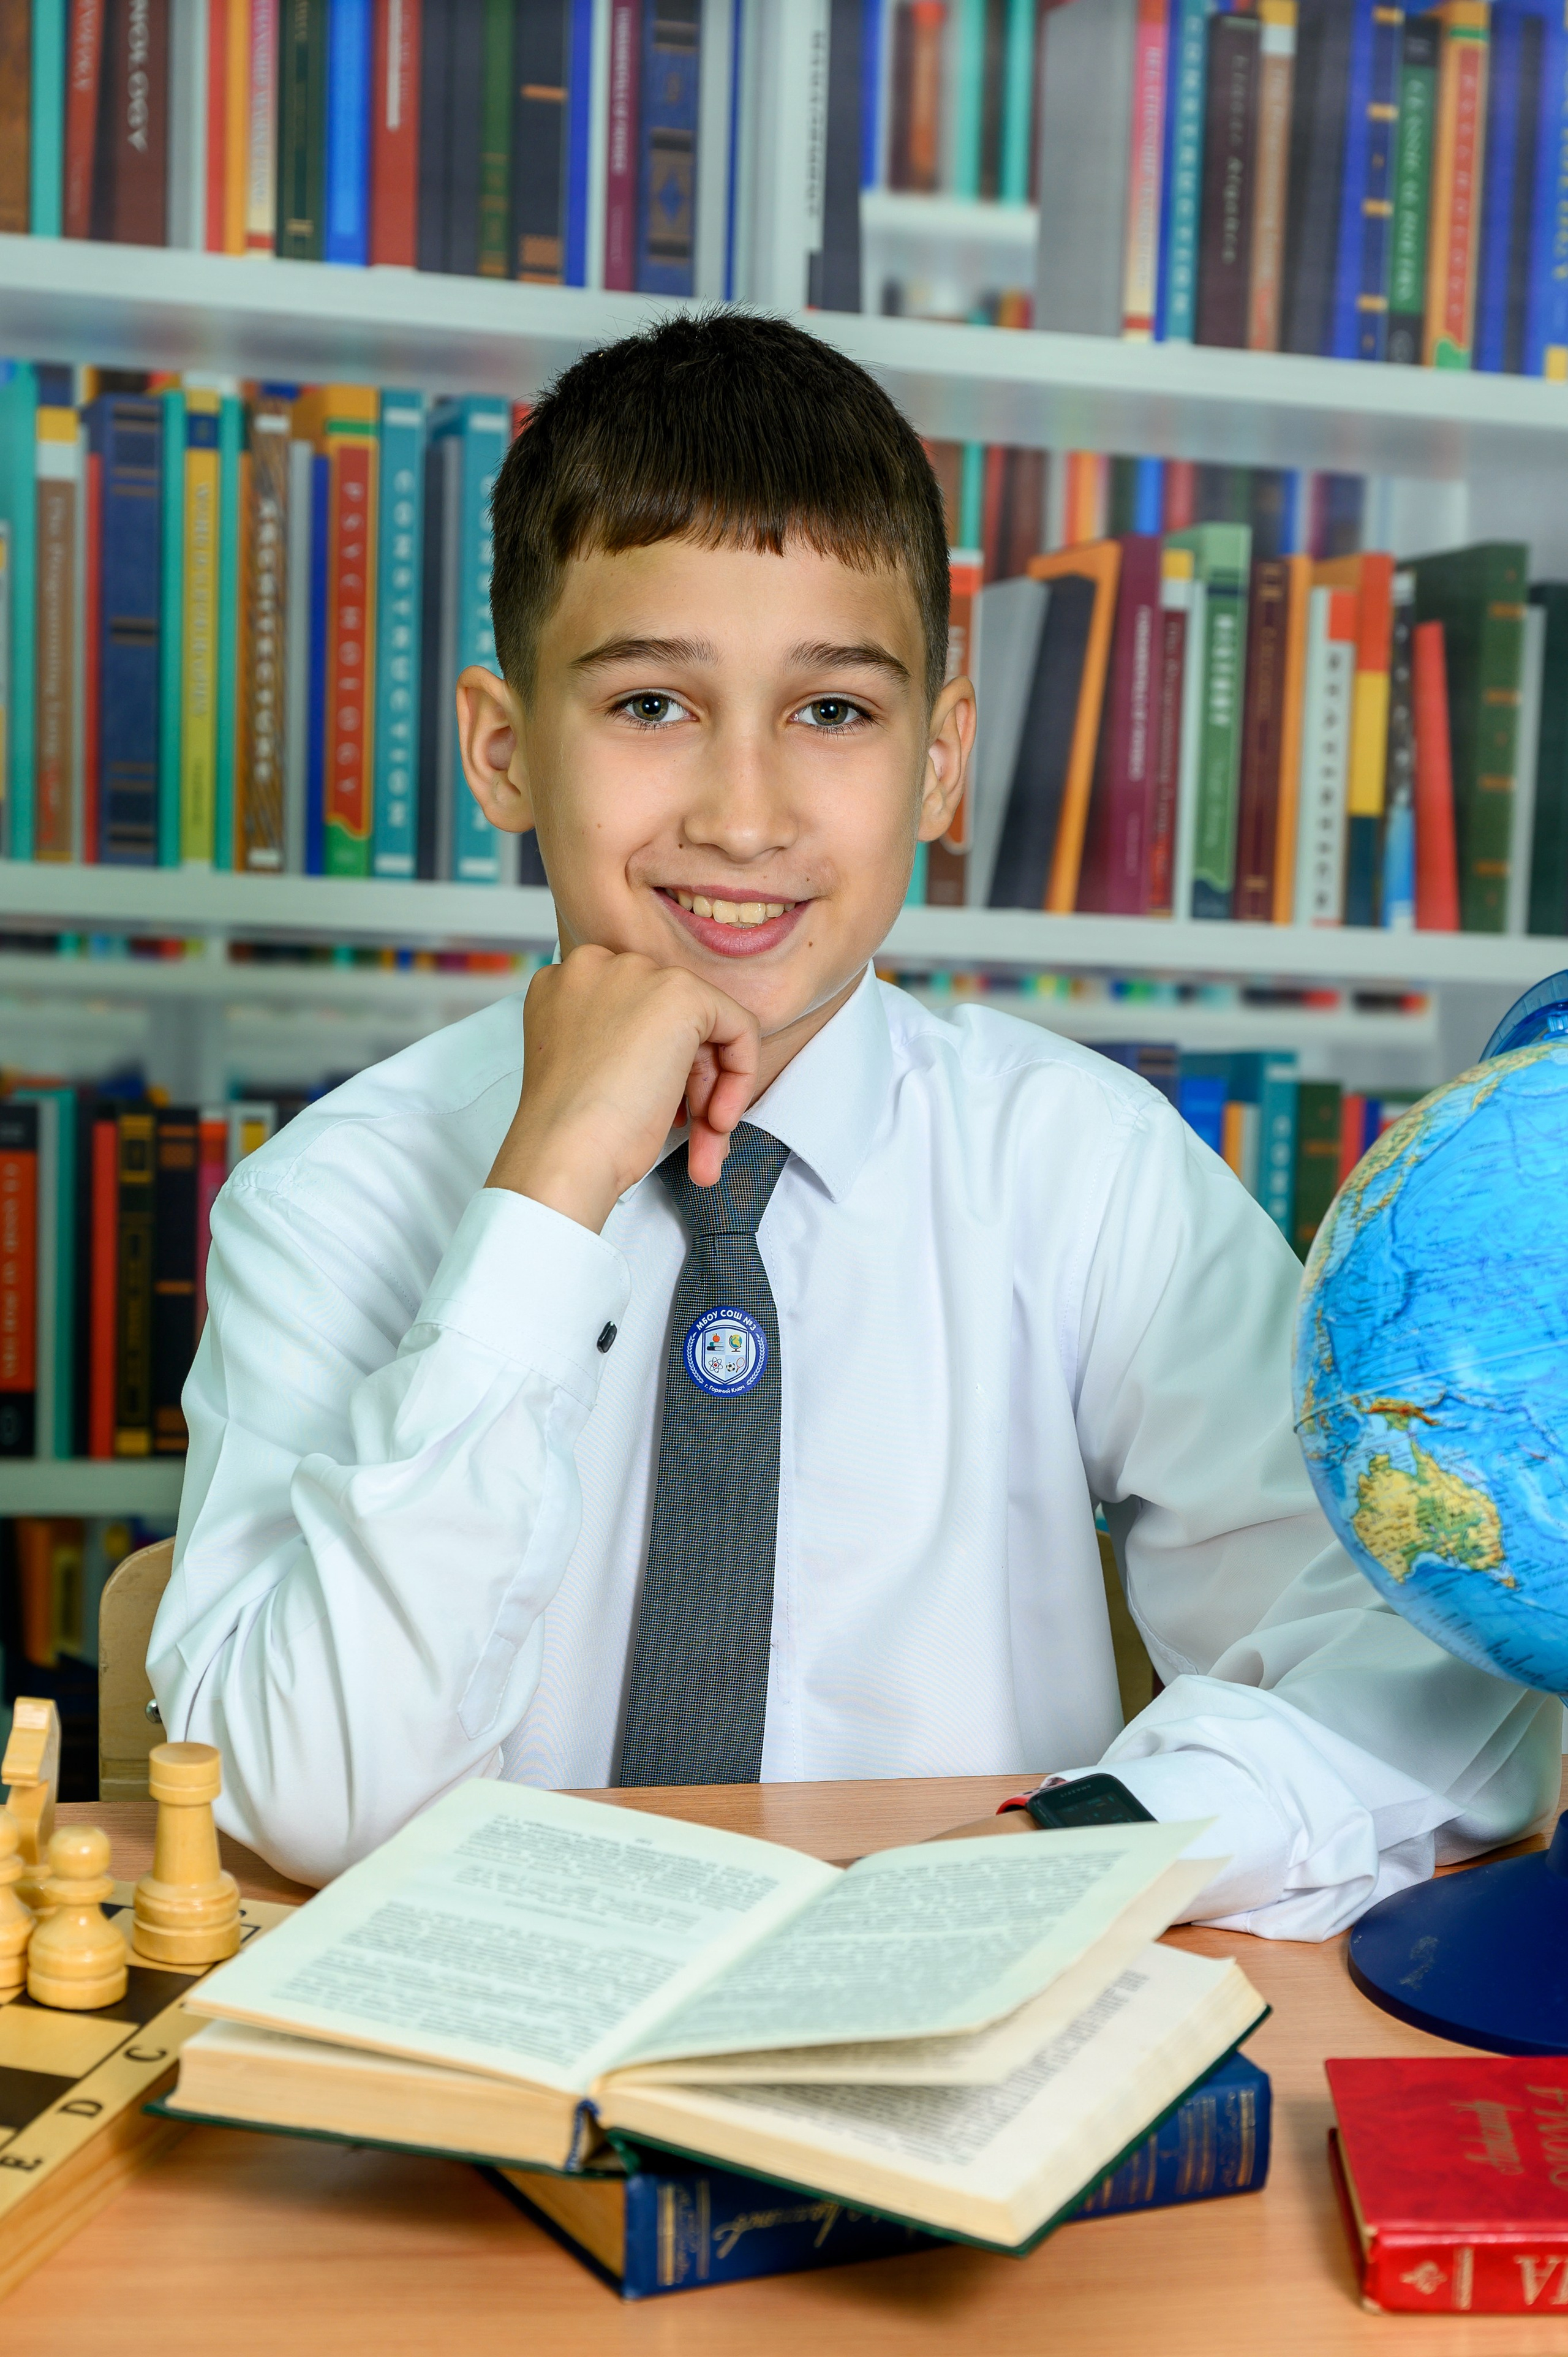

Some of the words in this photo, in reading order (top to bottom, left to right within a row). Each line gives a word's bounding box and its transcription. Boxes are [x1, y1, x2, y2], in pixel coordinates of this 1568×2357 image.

[336, 482, 363, 796] PSYCHOLOGY
[388, 470, 415, 827] CONSTRUCTION
[696, 1310, 718, 1331] МБОУ
[720, 1310, 742, 1320] СОШ
[708, 1386, 731, 1394] Горячий
[731, 1385, 745, 1393] Ключ
[123, 2044, 168, 2063] C
[56, 2098, 104, 2119] D
[0, 2153, 43, 2172] E
